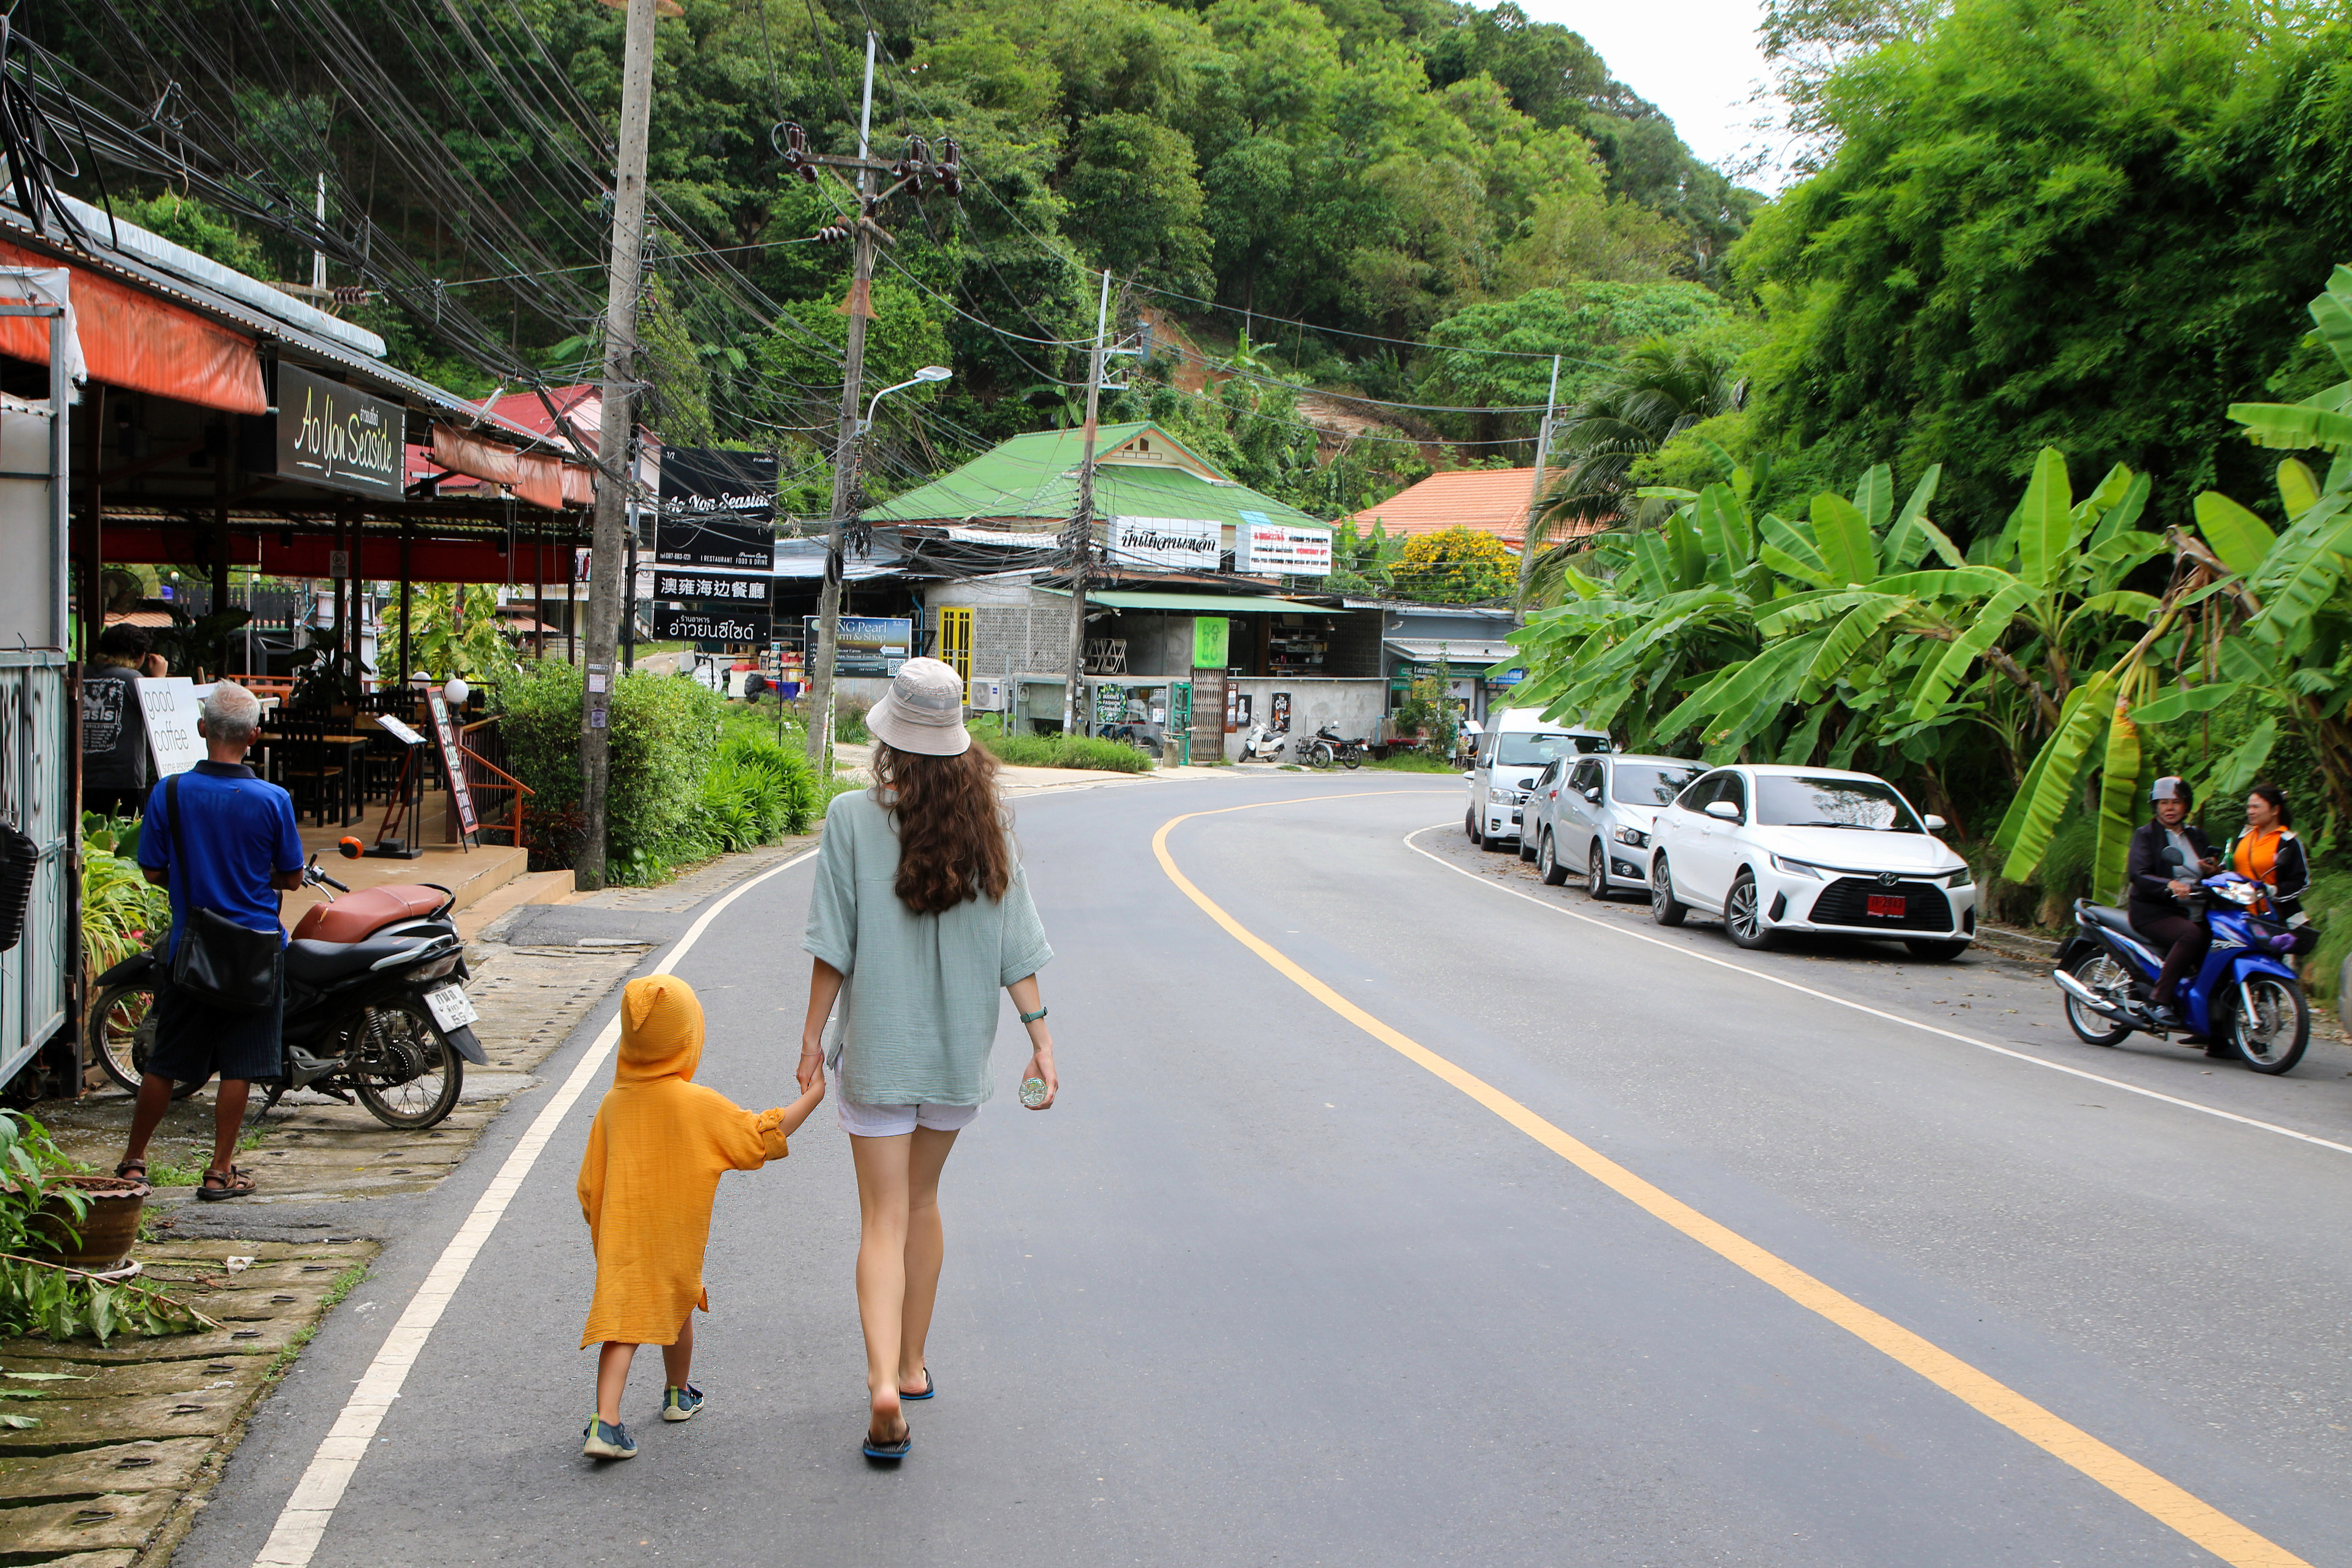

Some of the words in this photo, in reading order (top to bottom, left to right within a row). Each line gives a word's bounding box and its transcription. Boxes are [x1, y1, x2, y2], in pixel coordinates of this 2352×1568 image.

[294, 386, 321, 455] Ao
[323, 394, 346, 478] Yon
[348, 413, 393, 474] Seaside
[704, 555, 733, 564] RESTAURANT
[681, 614, 710, 623] ร้านอาหาร
[669, 619, 754, 640] อ่าวยนซีไซด์
[858, 621, 887, 633] Pearl
[864, 632, 886, 644] Shop
[145, 682, 175, 720] good
[432, 697, 447, 719] OPEN
[83, 710, 114, 721] asis
[154, 720, 189, 751] coffee
[162, 762, 176, 774] some
